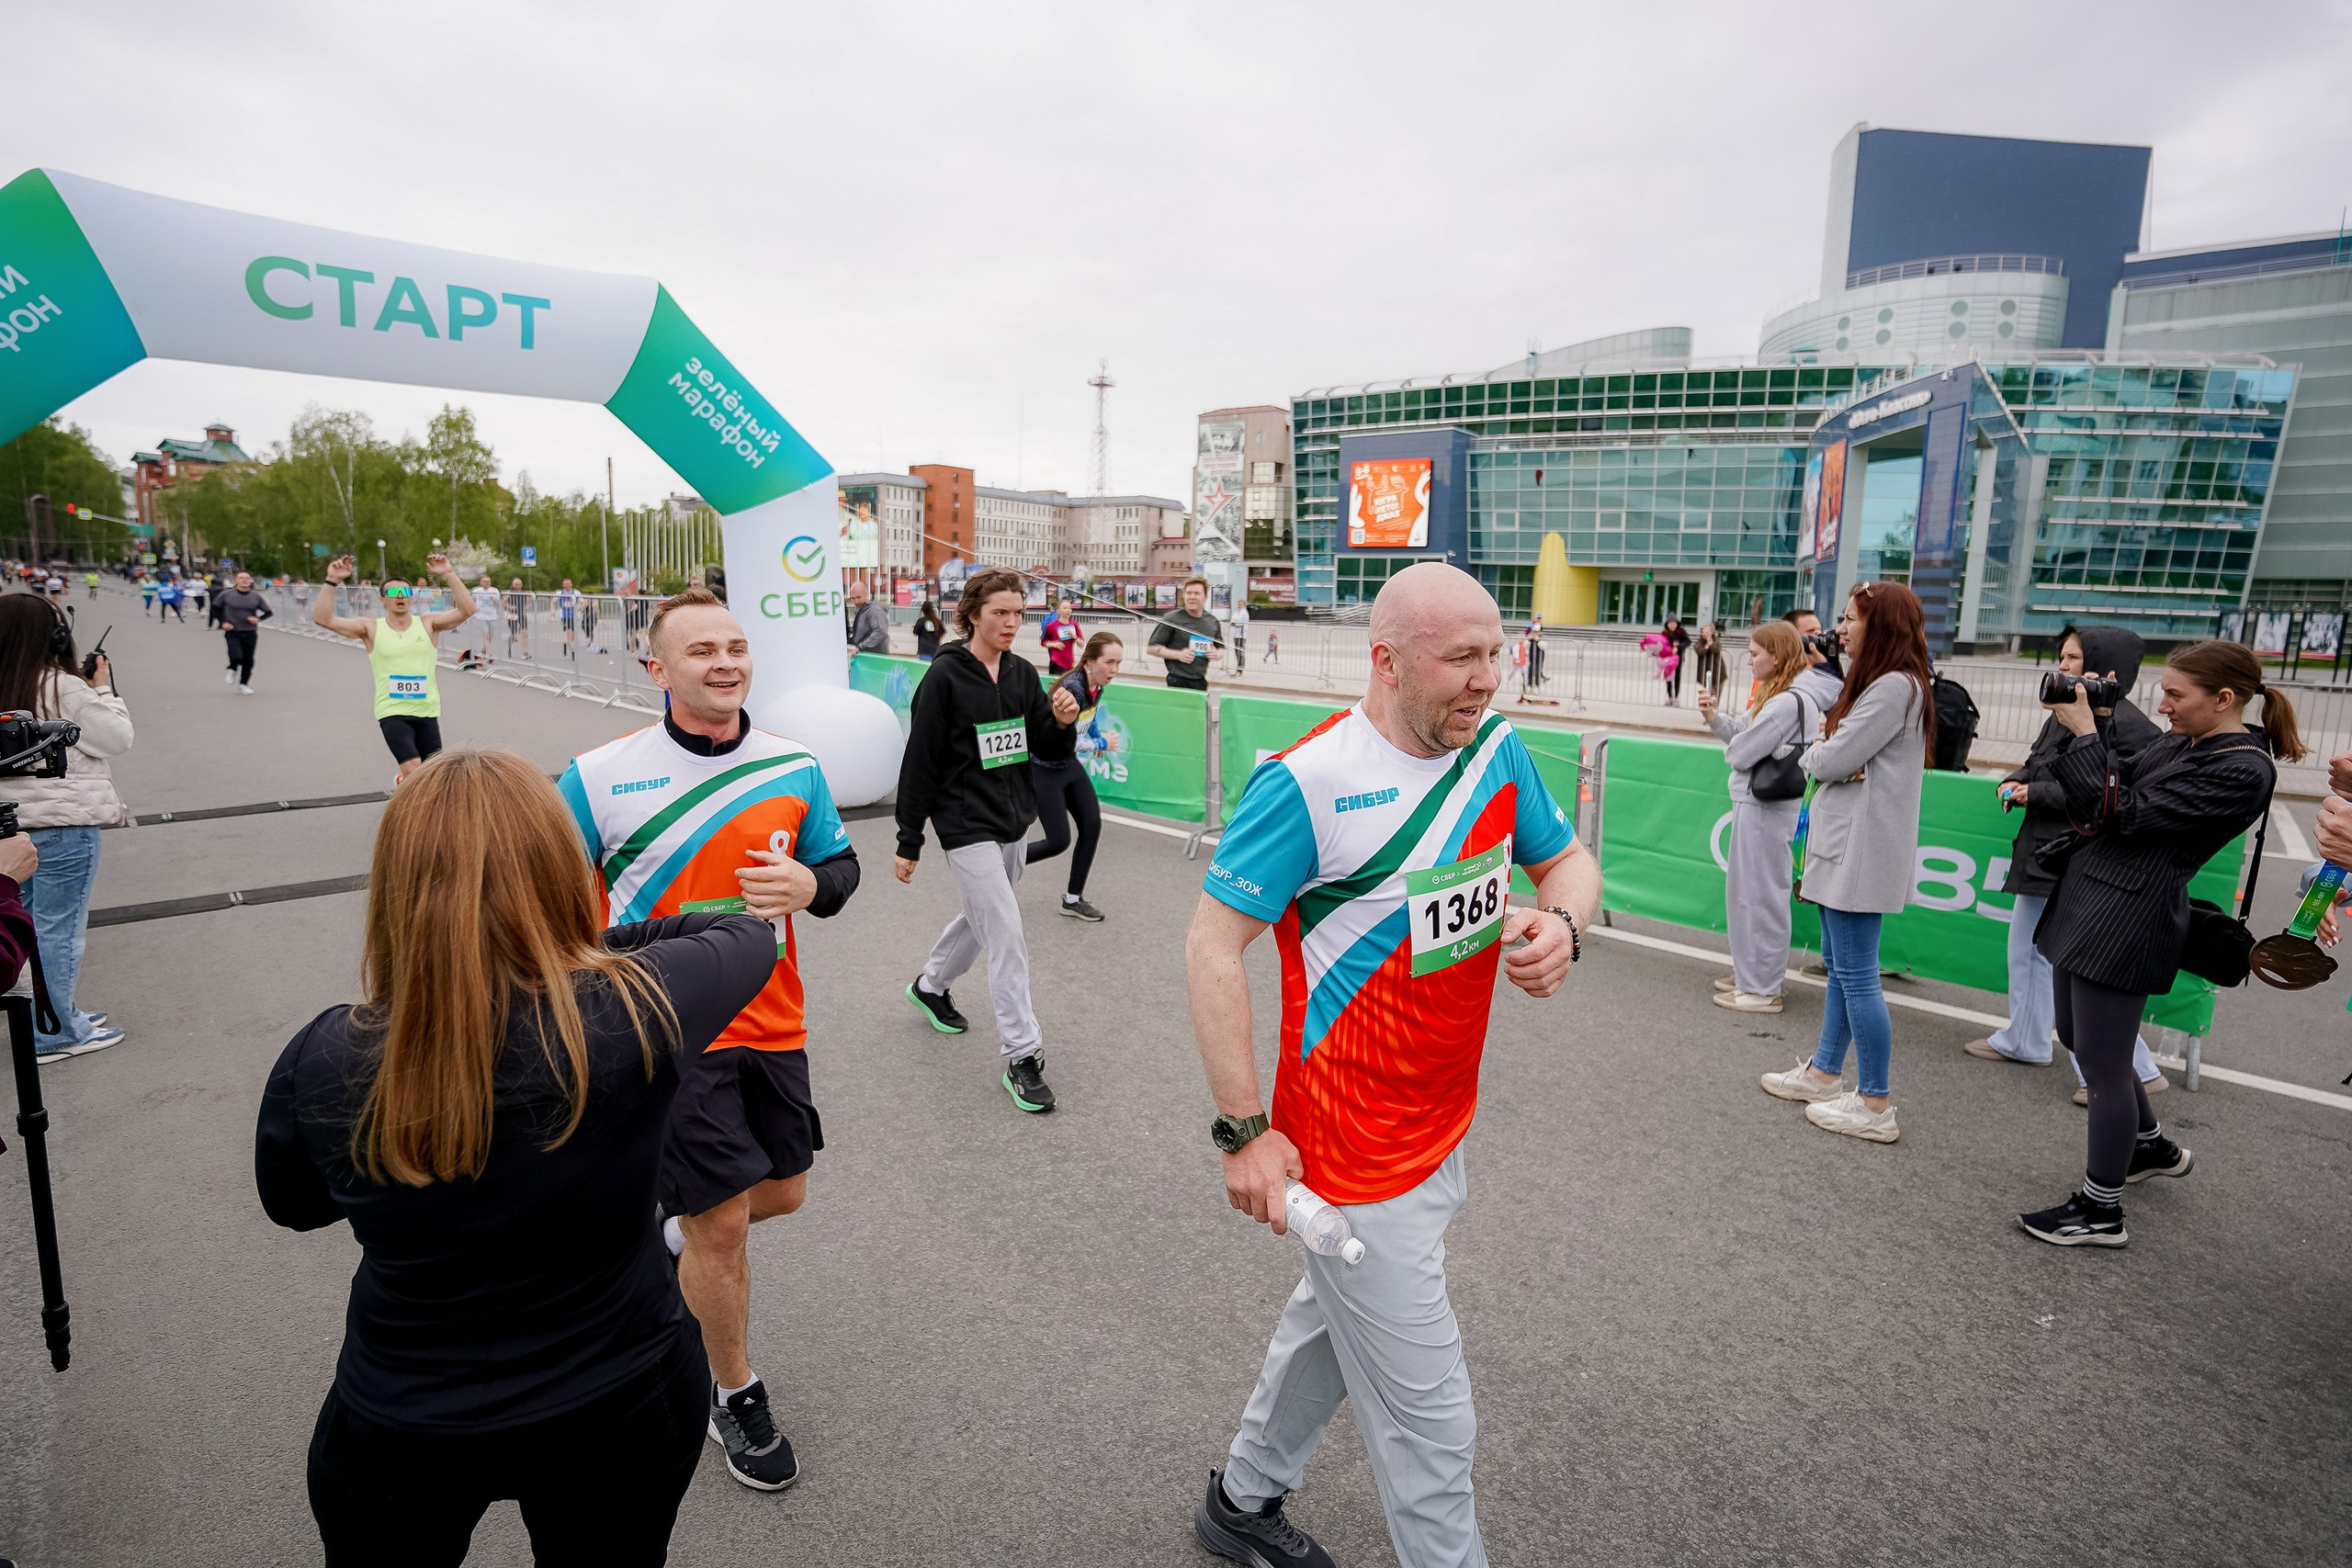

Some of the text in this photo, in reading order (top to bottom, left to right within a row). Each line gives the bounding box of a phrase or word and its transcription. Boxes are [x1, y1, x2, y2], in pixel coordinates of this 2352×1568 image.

[245, 255, 551, 351] СТАРТ
[684, 355, 782, 455] зелёный
[667, 371, 766, 469] марафон
[760, 591, 842, 620] СБЕР
[1194, 642, 1209, 651] 900
[397, 682, 420, 693] 803
[985, 731, 1023, 754] 1222
[611, 776, 671, 796] СИБУР
[1334, 786, 1400, 814] СИБУР
[1440, 872, 1456, 883] СБЕР
[1424, 877, 1499, 941] 1368
